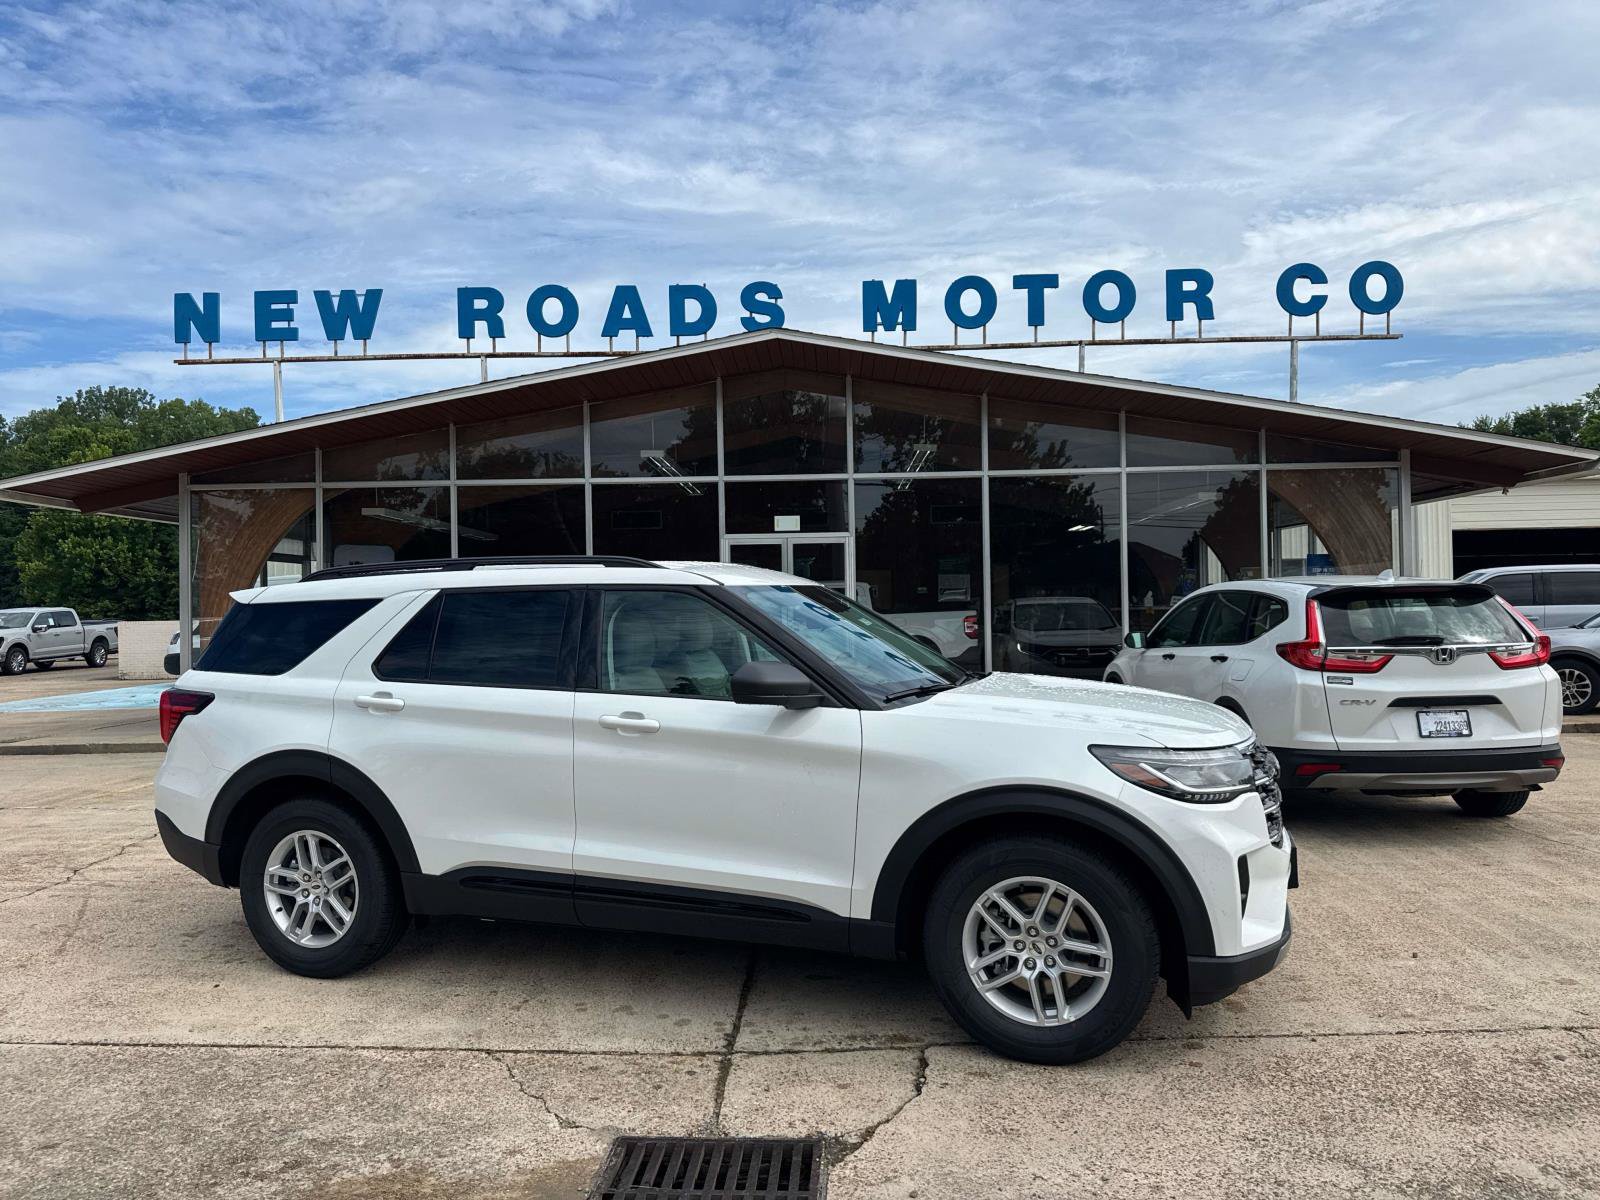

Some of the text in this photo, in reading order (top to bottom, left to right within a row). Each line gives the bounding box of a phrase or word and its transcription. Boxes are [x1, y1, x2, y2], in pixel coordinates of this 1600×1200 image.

[173, 260, 1405, 346] NEW ROADS MOTOR CO
